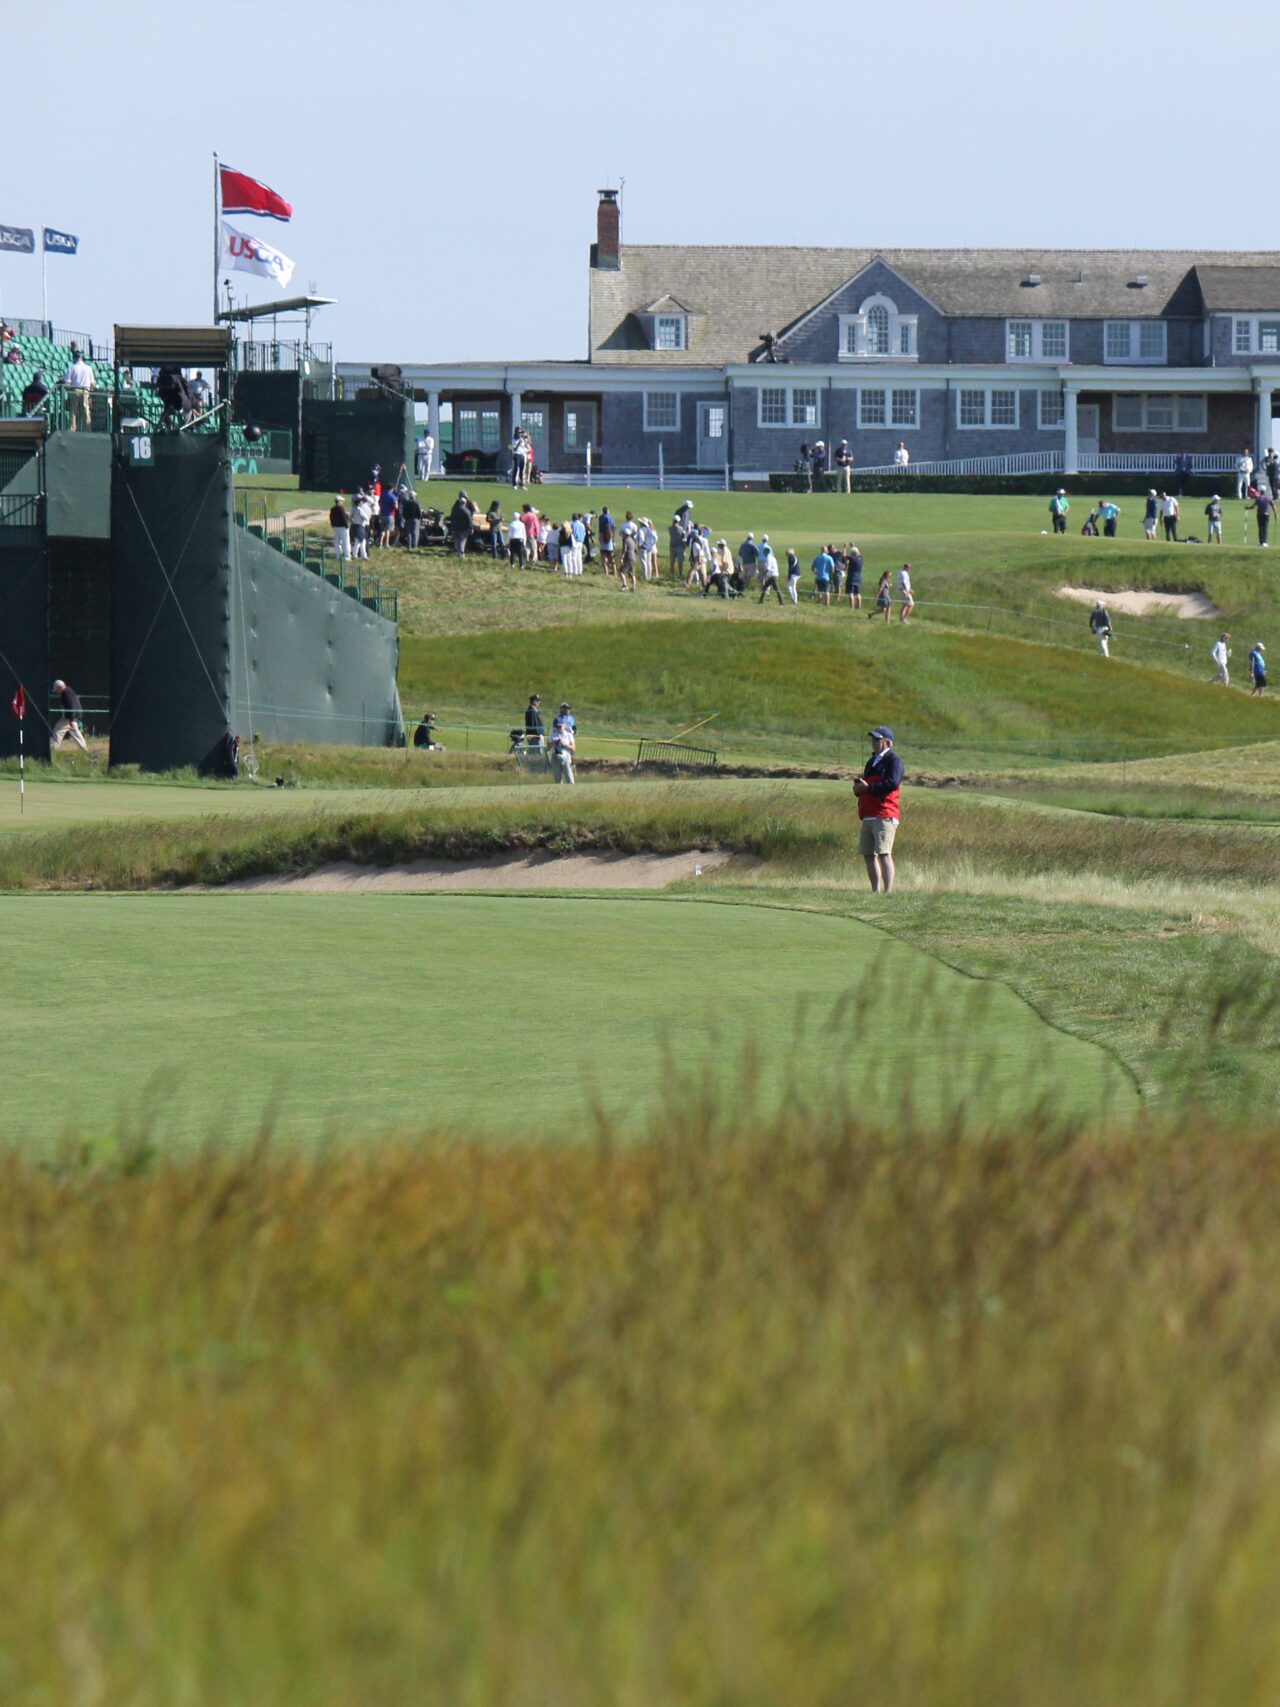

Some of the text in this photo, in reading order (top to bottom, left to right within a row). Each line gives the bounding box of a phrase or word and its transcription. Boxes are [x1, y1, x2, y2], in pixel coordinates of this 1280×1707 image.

[46, 232, 76, 248] USGA
[229, 236, 284, 271] USGA
[131, 436, 151, 459] 16
